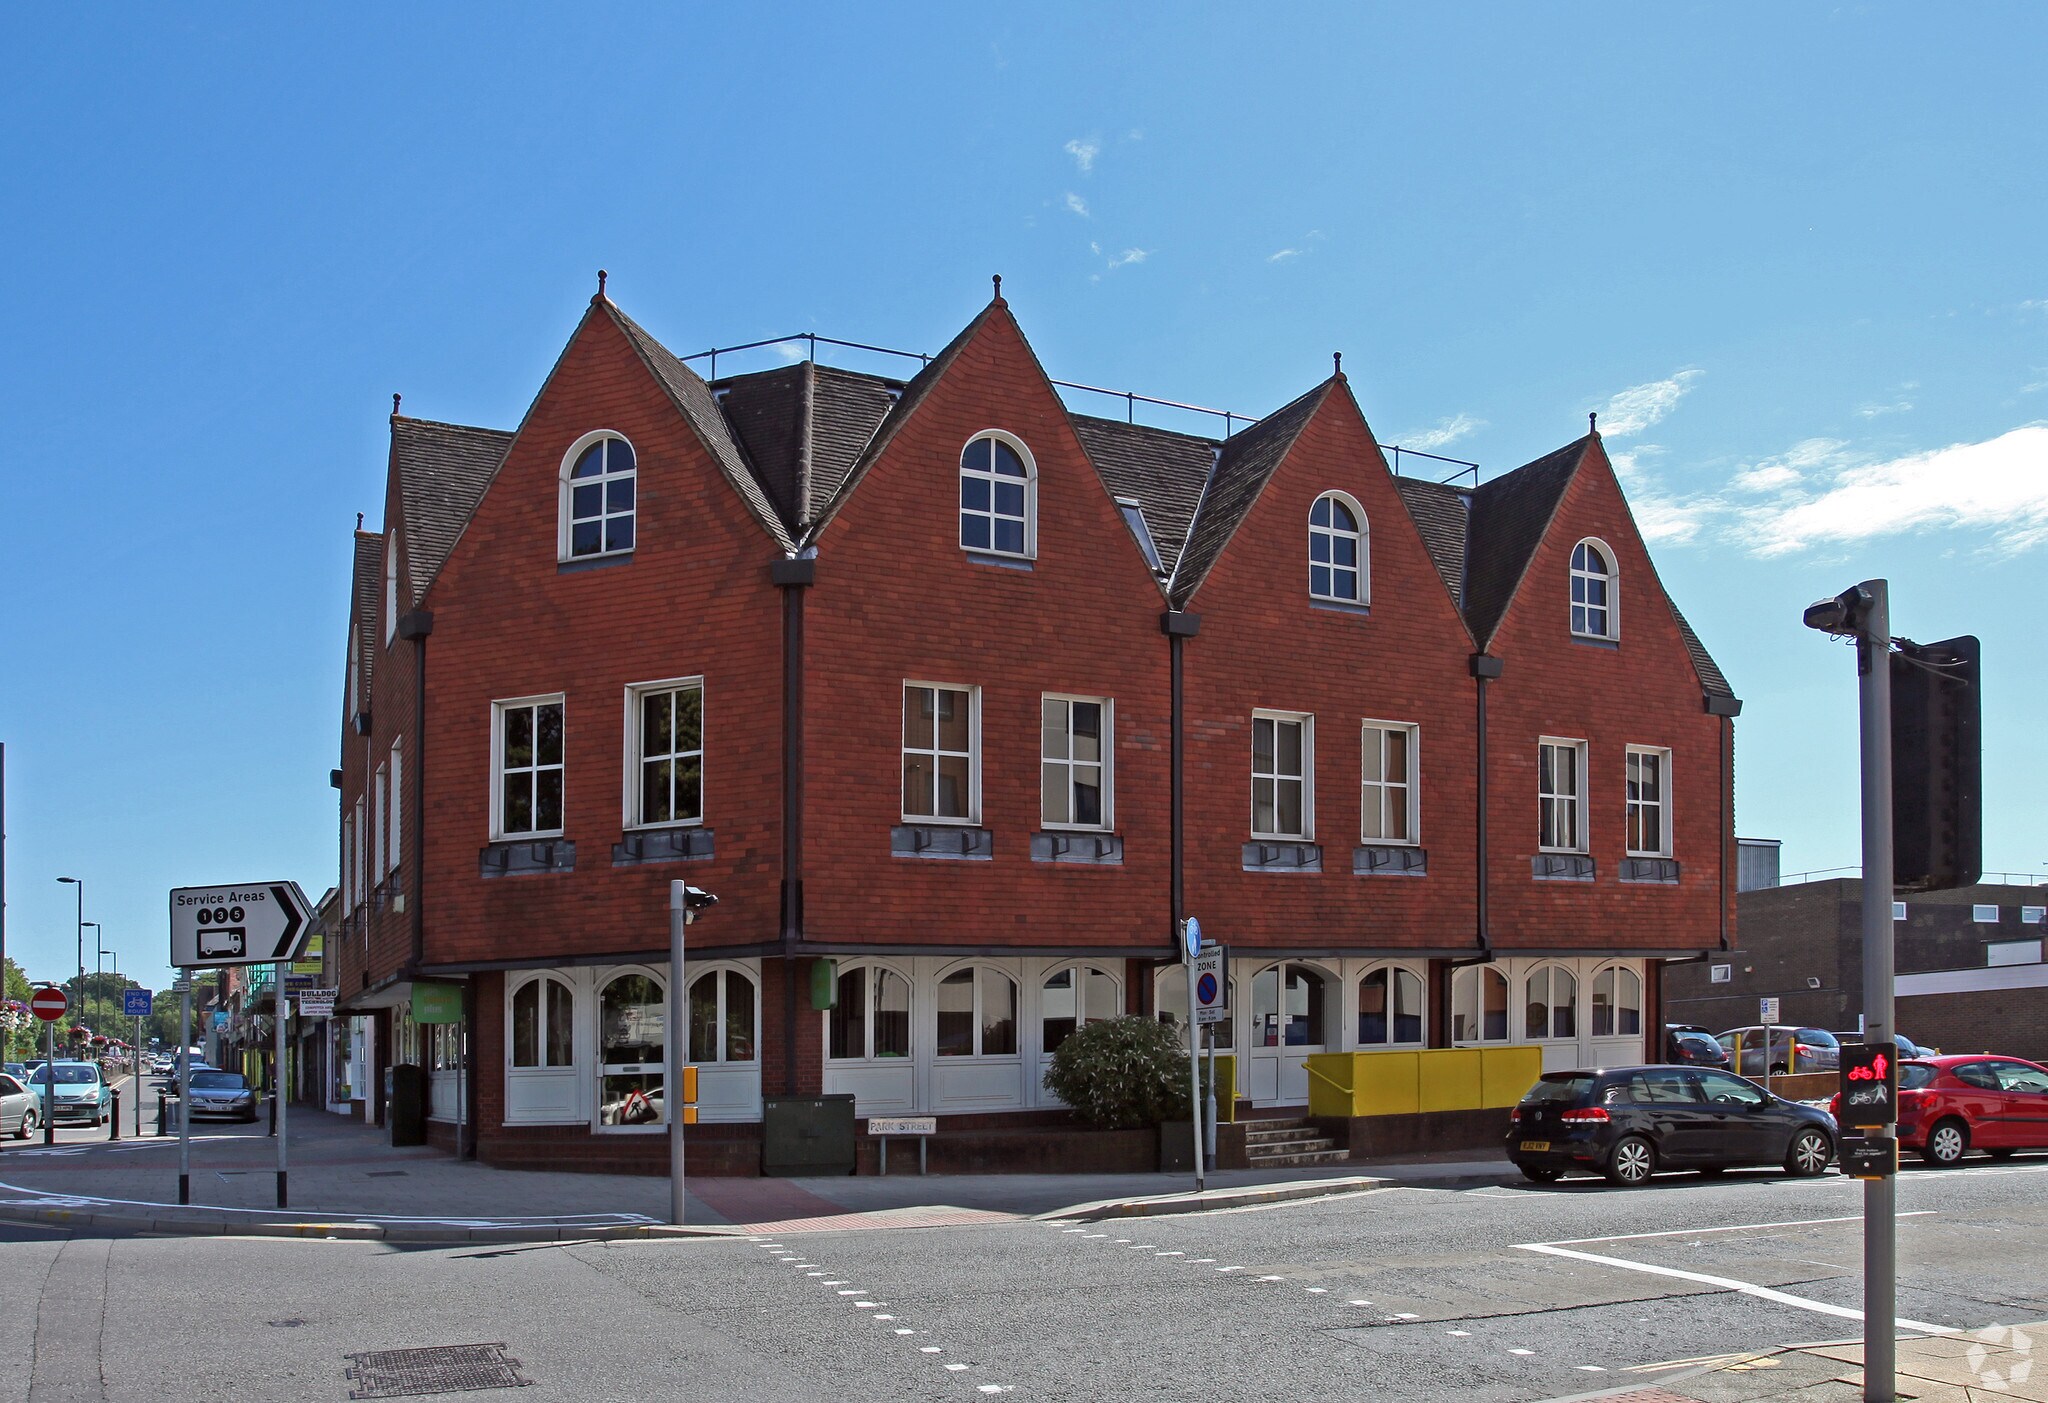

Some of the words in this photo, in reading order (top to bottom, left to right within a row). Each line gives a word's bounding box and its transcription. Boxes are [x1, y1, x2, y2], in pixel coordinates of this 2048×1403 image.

[177, 893, 224, 906] Service
[228, 891, 265, 903] Areas
[1198, 949, 1220, 959] ontrolled
[1197, 960, 1216, 971] ZONE
[870, 1122, 895, 1132] PARK
[899, 1121, 933, 1131] STREET
